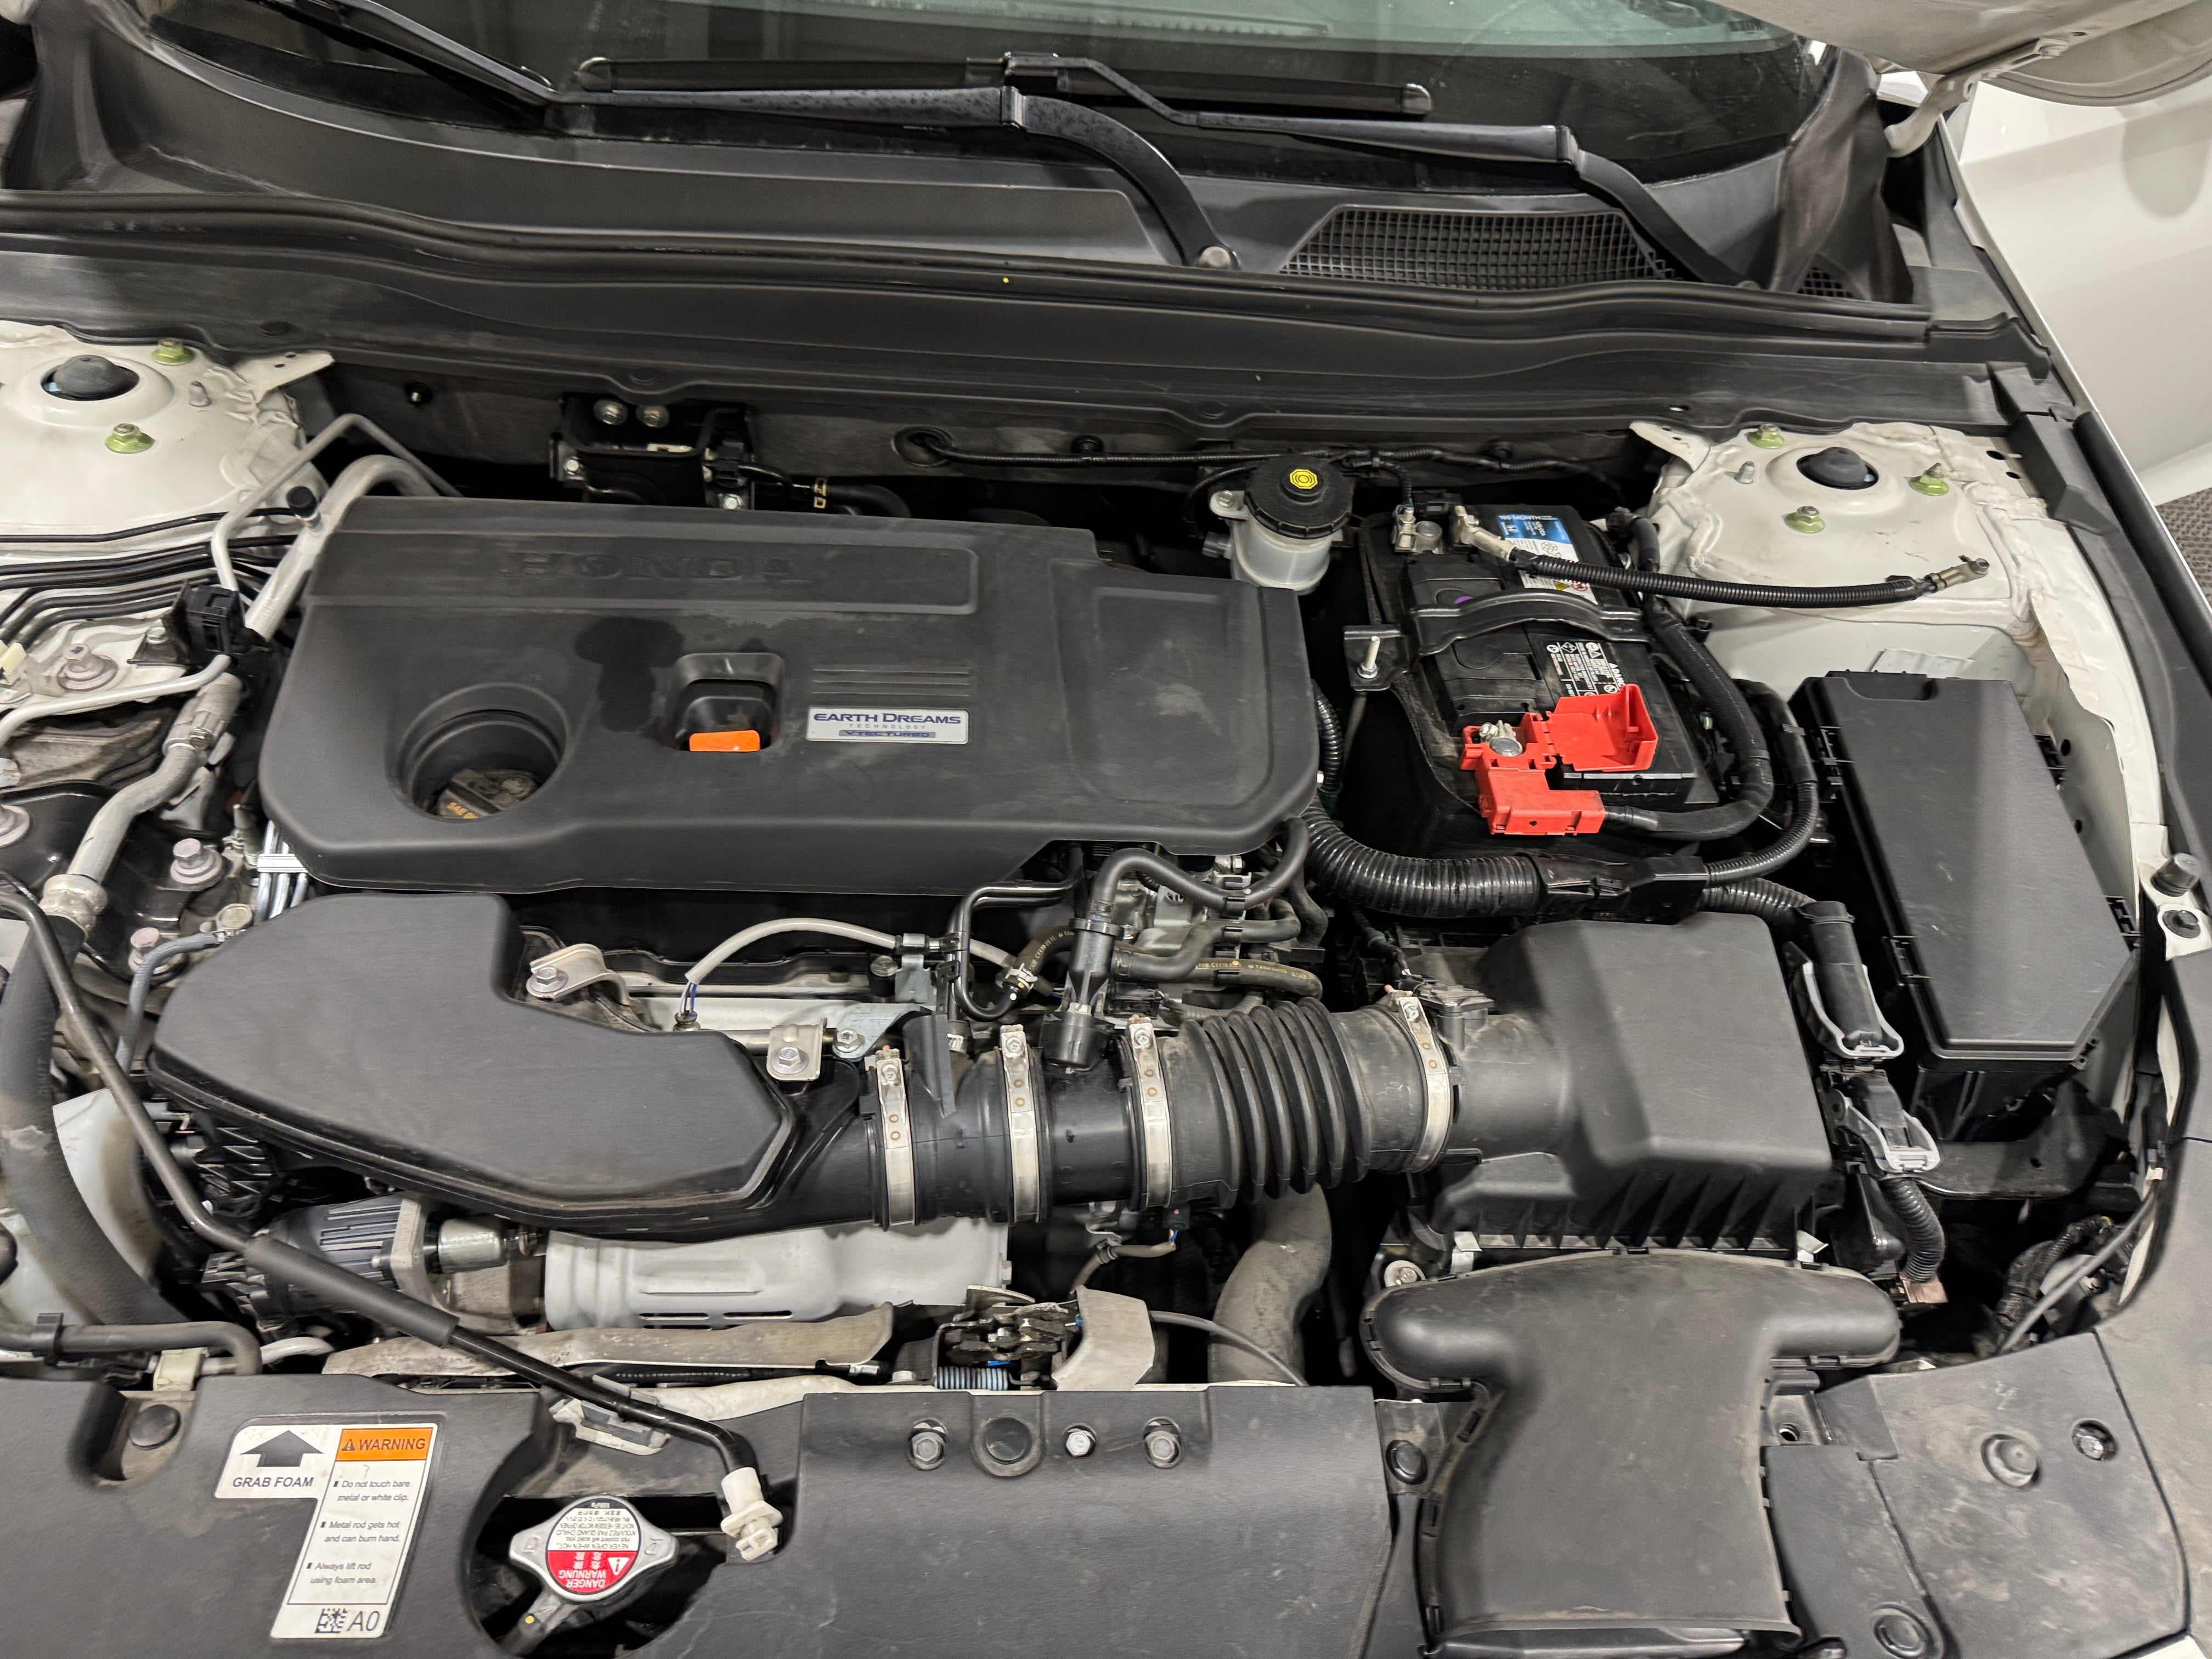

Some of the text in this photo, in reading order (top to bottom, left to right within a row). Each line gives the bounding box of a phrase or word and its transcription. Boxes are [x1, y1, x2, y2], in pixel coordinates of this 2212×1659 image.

[814, 713, 961, 724] EARTH DREAMS
[447, 802, 467, 816] SAE
[359, 1438, 426, 1451] WARNING
[233, 1477, 314, 1487] GRAB FOAM
[393, 1494, 409, 1502] clip.
[314, 1562, 345, 1571] Always
[558, 1570, 606, 1579] WARNUNG
[311, 1577, 333, 1585] using
[565, 1579, 605, 1588] DANGER
